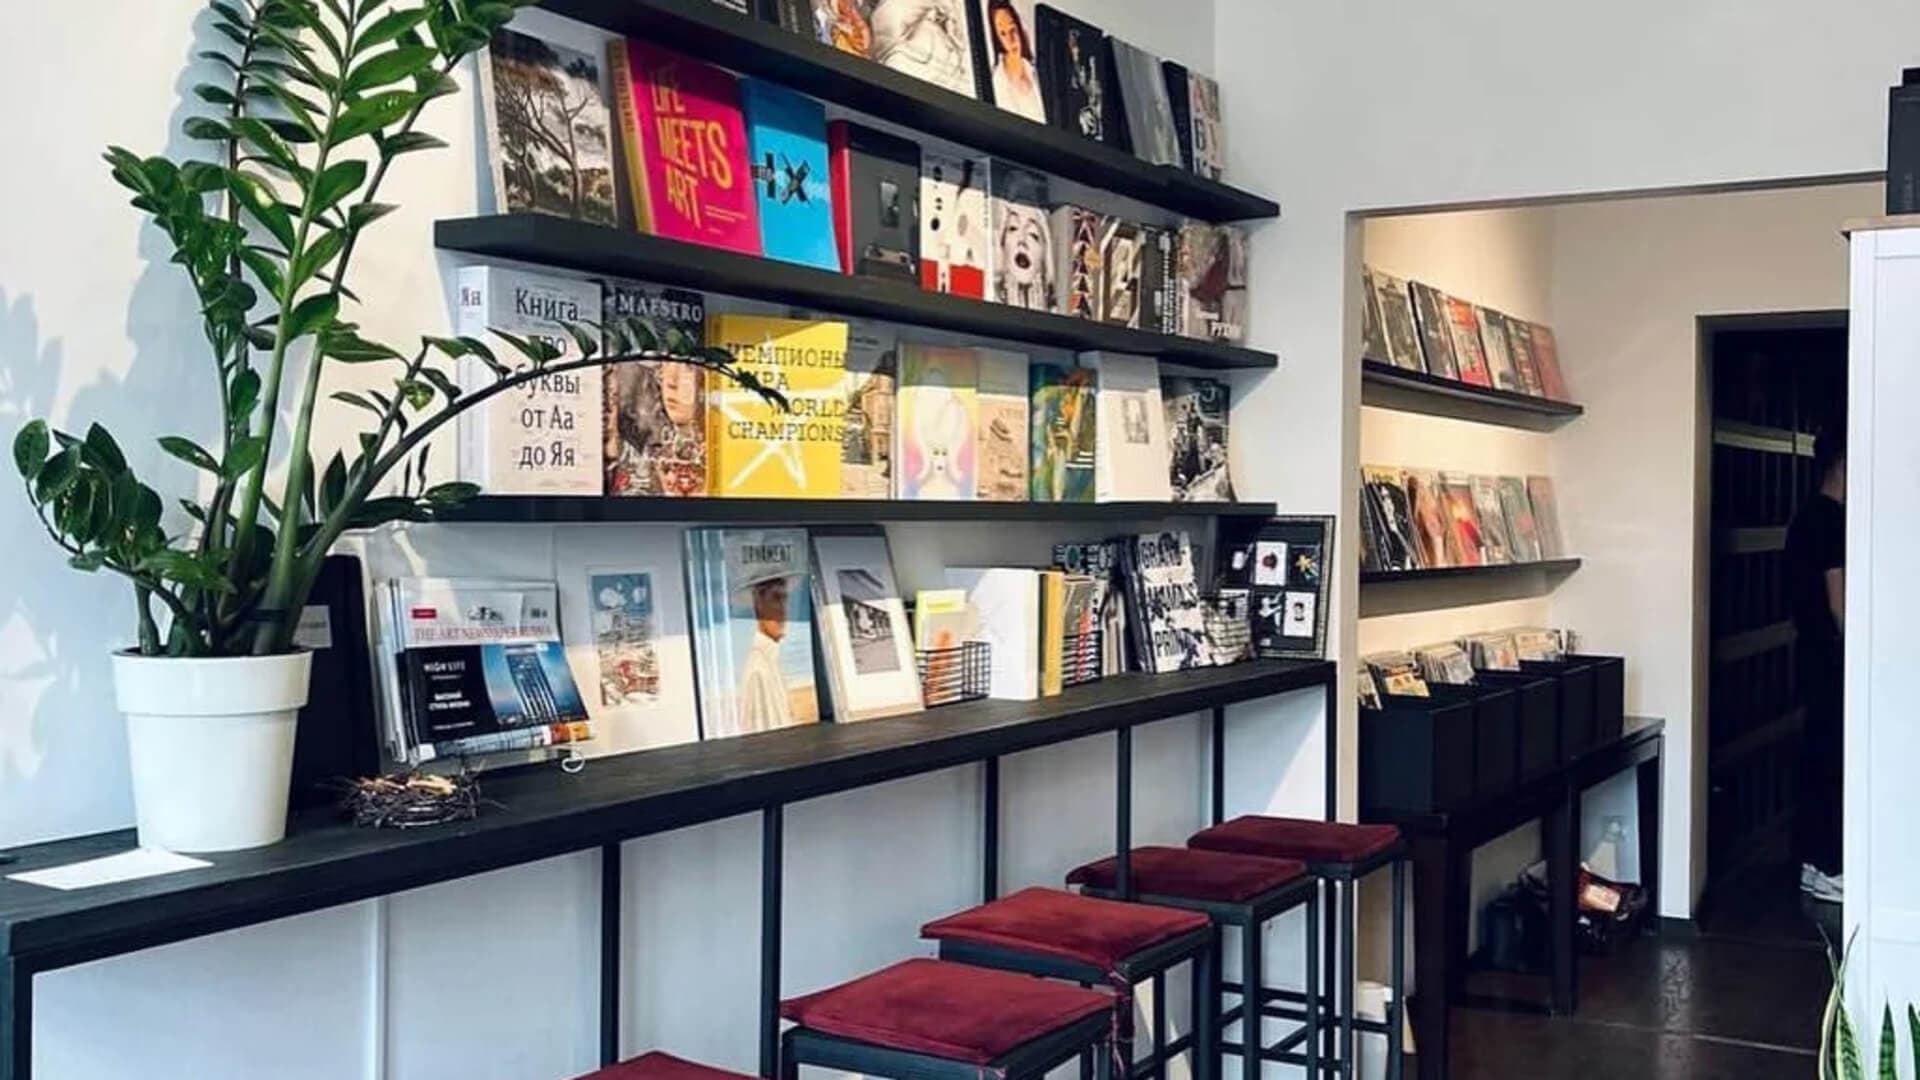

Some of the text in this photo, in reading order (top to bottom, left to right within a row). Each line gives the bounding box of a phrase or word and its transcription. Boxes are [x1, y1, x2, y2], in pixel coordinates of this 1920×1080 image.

[656, 116, 733, 189] MEETS
[666, 163, 701, 229] ART
[515, 287, 579, 321] Книга
[618, 293, 703, 323] MAESTRO
[521, 404, 574, 430] от Аа
[771, 397, 846, 417] ORLD
[727, 421, 846, 441] CHAMPIONS
[519, 441, 575, 470] до Яя
